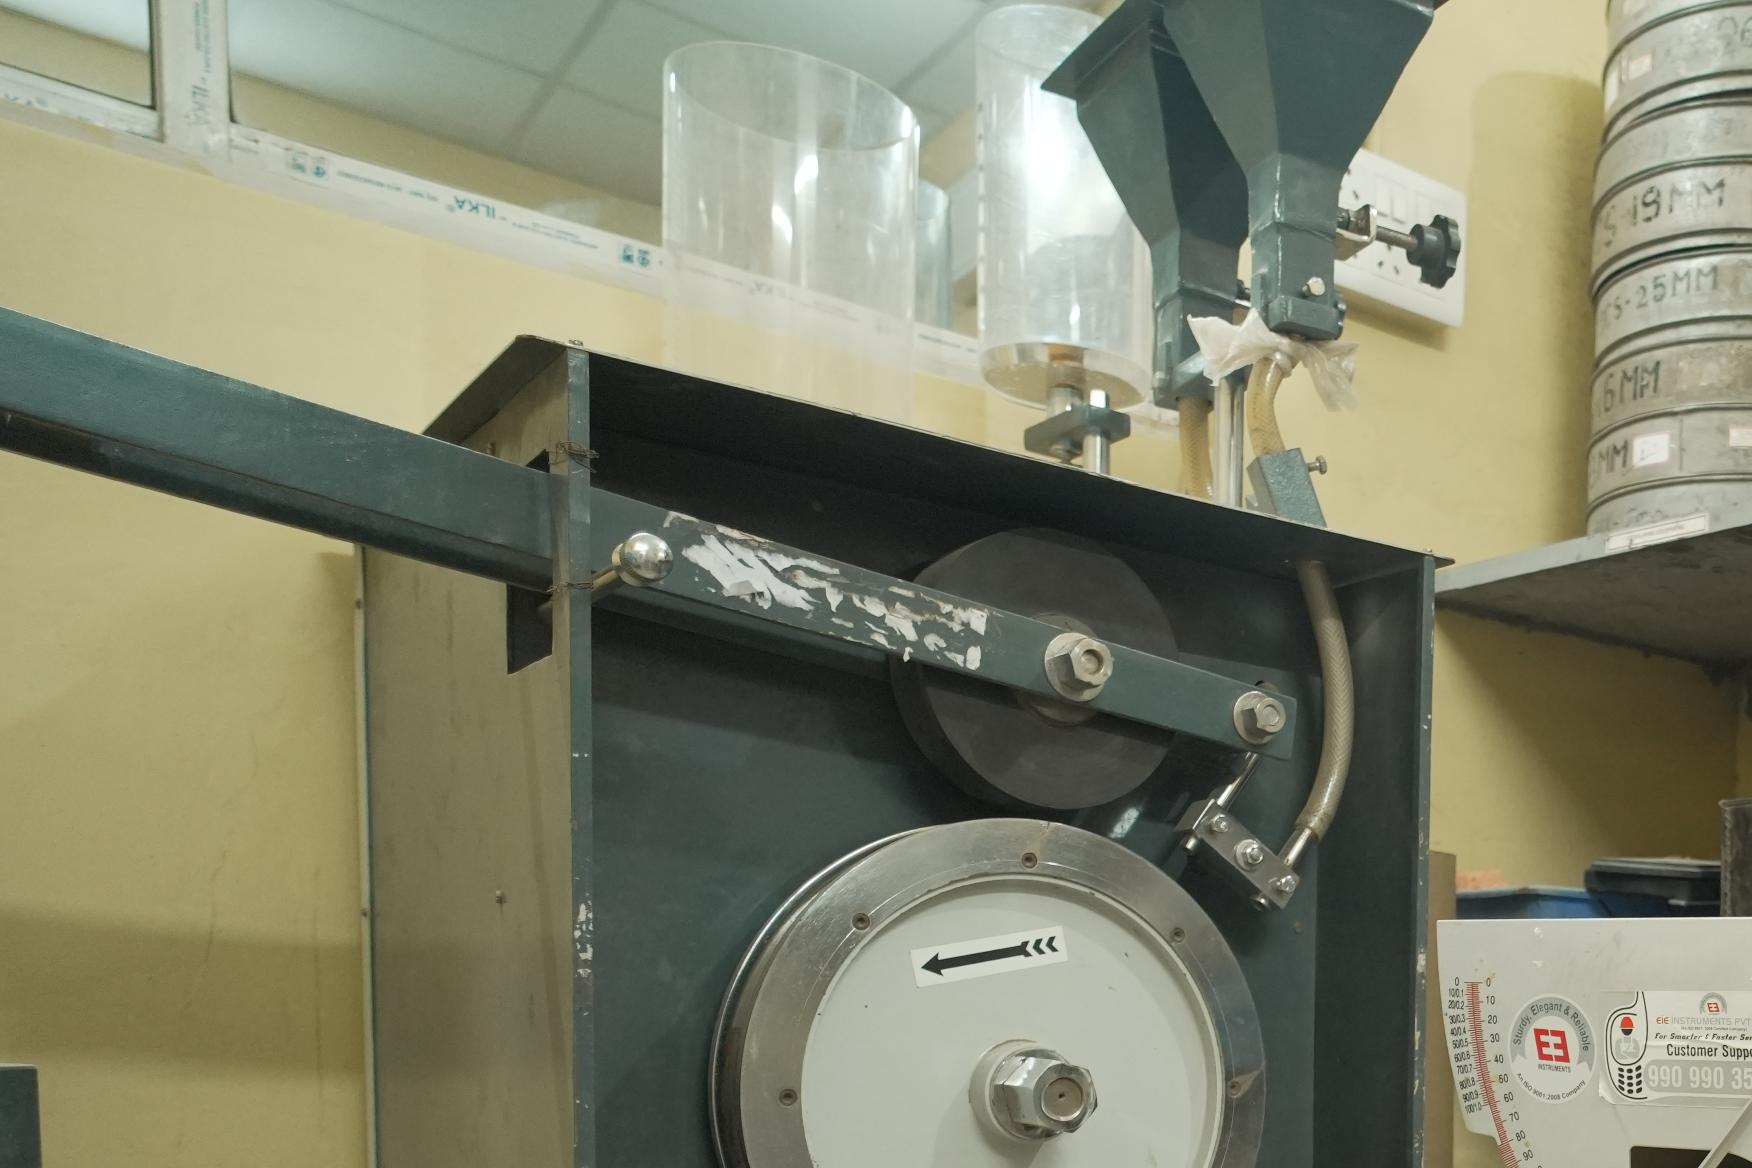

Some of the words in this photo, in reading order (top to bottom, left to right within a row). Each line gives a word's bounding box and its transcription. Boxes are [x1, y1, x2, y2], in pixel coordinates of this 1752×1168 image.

[454, 196, 496, 219] ILKA
[1486, 977, 1491, 987] 0
[1486, 995, 1496, 1006] 10
[1487, 1015, 1498, 1025] 20
[1671, 1017, 1732, 1026] INSTRUMENTS
[1734, 1017, 1751, 1026] PVT
[1530, 1003, 1562, 1016] Elegant
[1563, 1006, 1570, 1016] &
[1570, 1012, 1591, 1052] Reliable
[1490, 1033, 1500, 1043] 30
[1655, 1032, 1667, 1040] For
[1670, 1032, 1702, 1041] Smarter
[1711, 1033, 1737, 1041] Faster
[1666, 1043, 1718, 1057] Customer
[1494, 1054, 1504, 1065] 40
[1538, 1063, 1572, 1074] INSTRUMENTS
[1498, 1073, 1509, 1084] 50
[1648, 1065, 1682, 1088] 990
[1689, 1066, 1724, 1089] 990
[1562, 1080, 1586, 1099] Company
[1503, 1091, 1514, 1103] 60
[1508, 1111, 1520, 1123] 70
[1515, 1130, 1526, 1142] 80
[1522, 1149, 1534, 1161] 90
